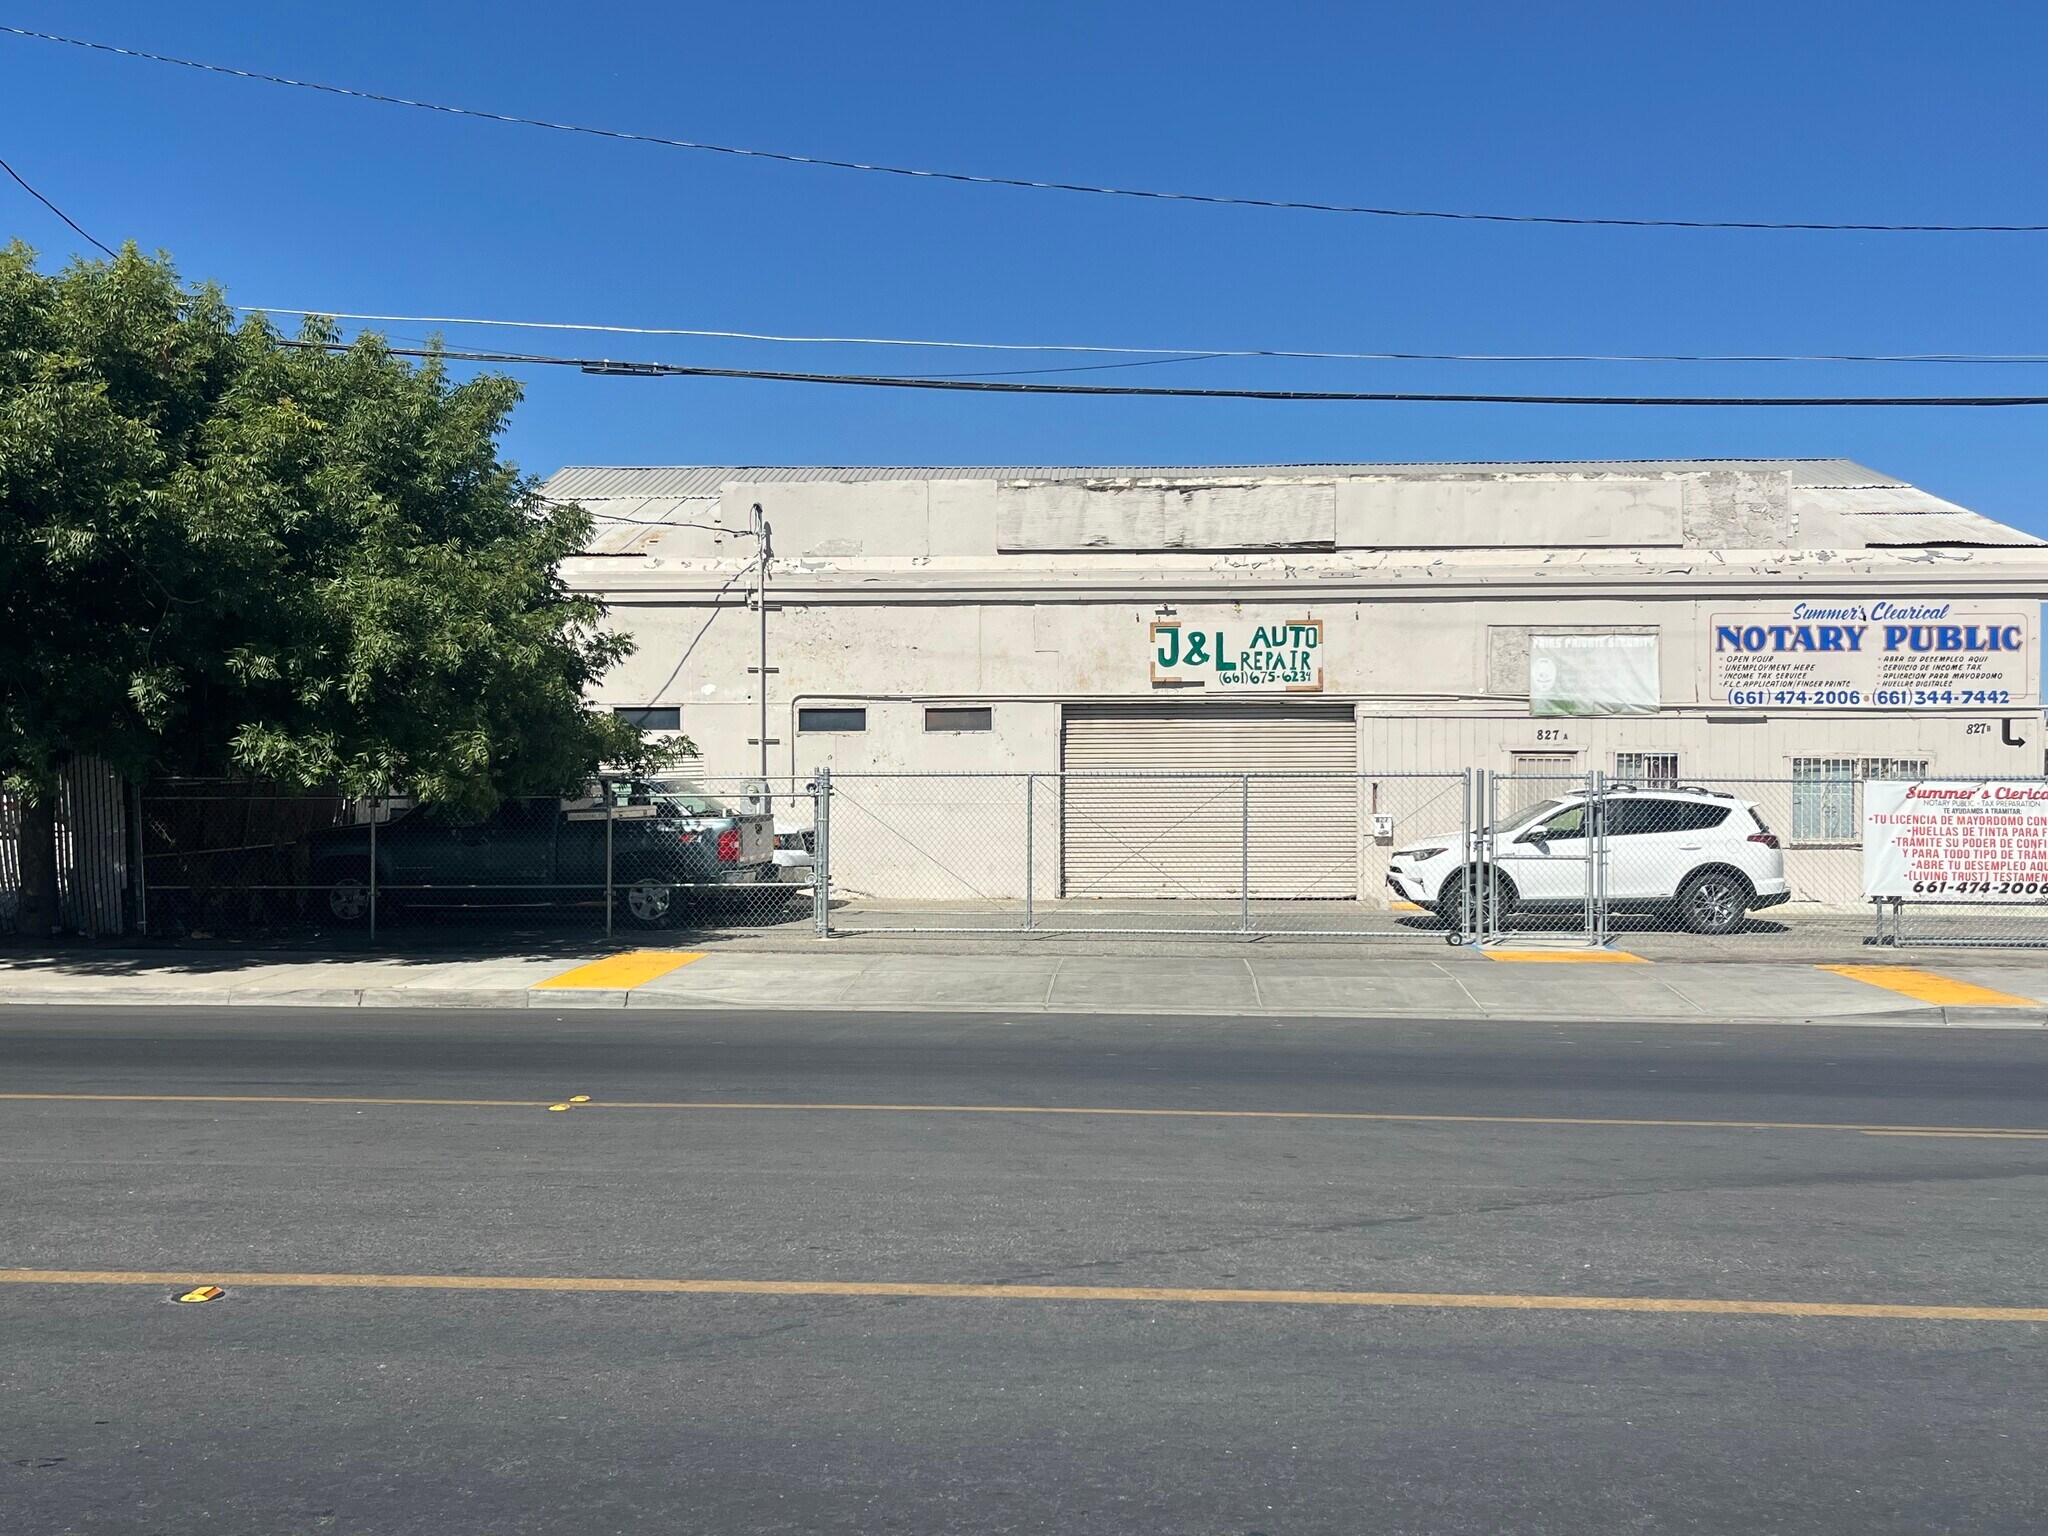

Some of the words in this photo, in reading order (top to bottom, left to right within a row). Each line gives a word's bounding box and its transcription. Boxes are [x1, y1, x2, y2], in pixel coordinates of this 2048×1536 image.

[1792, 602, 1867, 621] Summer's
[1870, 601, 1950, 621] Clearical
[1249, 625, 1318, 649] AUTO
[1715, 625, 1868, 652] NOTARY
[1883, 625, 2023, 652] PUBLIC
[1240, 650, 1312, 671] REPAIR
[1726, 655, 1750, 663] OPEN
[1751, 655, 1775, 663] YOUR
[1883, 655, 1905, 663] ABRA
[1907, 655, 1918, 663] SU
[1919, 655, 1964, 663] DESEMPLEO
[1724, 664, 1791, 672] UNEMPLOYMENT
[1723, 672, 1754, 680] INCOME
[1757, 672, 1773, 680] TAX
[1775, 672, 1807, 680] SERVICE
[1882, 672, 1927, 680] APLICACION
[1928, 672, 1949, 680] PARA
[1952, 672, 2003, 680] MAYORDOMO
[1727, 688, 1771, 705] (661)
[1774, 690, 1860, 705] 474-2006
[1914, 690, 2010, 705] 344-7442
[1965, 722, 1987, 735] 827
[1536, 729, 1560, 741] 827
[1563, 732, 1569, 740] A
[1923, 799, 1950, 807] NOTARY
[1951, 799, 1976, 807] PUBLIC
[1995, 800, 2041, 808] PREPARATION
[1951, 807, 1984, 815] AYUDAMOS
[1873, 814, 1887, 824] TU
[1889, 814, 1937, 825] LICENCIA
[1940, 815, 1954, 825] DE
[1956, 815, 2024, 826] MAYORDOMO
[2026, 816, 2048, 826] CON
[1911, 826, 1959, 837] HUELLAS
[1962, 826, 1975, 837] DE
[1977, 826, 2009, 837] TINTA
[2012, 827, 2039, 837] PARA
[1945, 837, 1959, 847] SU
[1962, 838, 1996, 848] PODER
[1999, 838, 2014, 848] DE
[2016, 838, 2048, 848] CONFI
[1902, 848, 1909, 858] Y
[1911, 848, 1940, 859] PARA
[1943, 848, 1970, 859] TODO
[1973, 849, 1997, 859] TIPO
[2000, 849, 2014, 860] DE
[1916, 859, 1945, 870] ABRE
[1948, 860, 1961, 870] TU
[1964, 860, 2027, 871] DESEMPLEO
[1992, 871, 2048, 883] TESTAMEN
[1912, 880, 2048, 894] 661-474-2006
